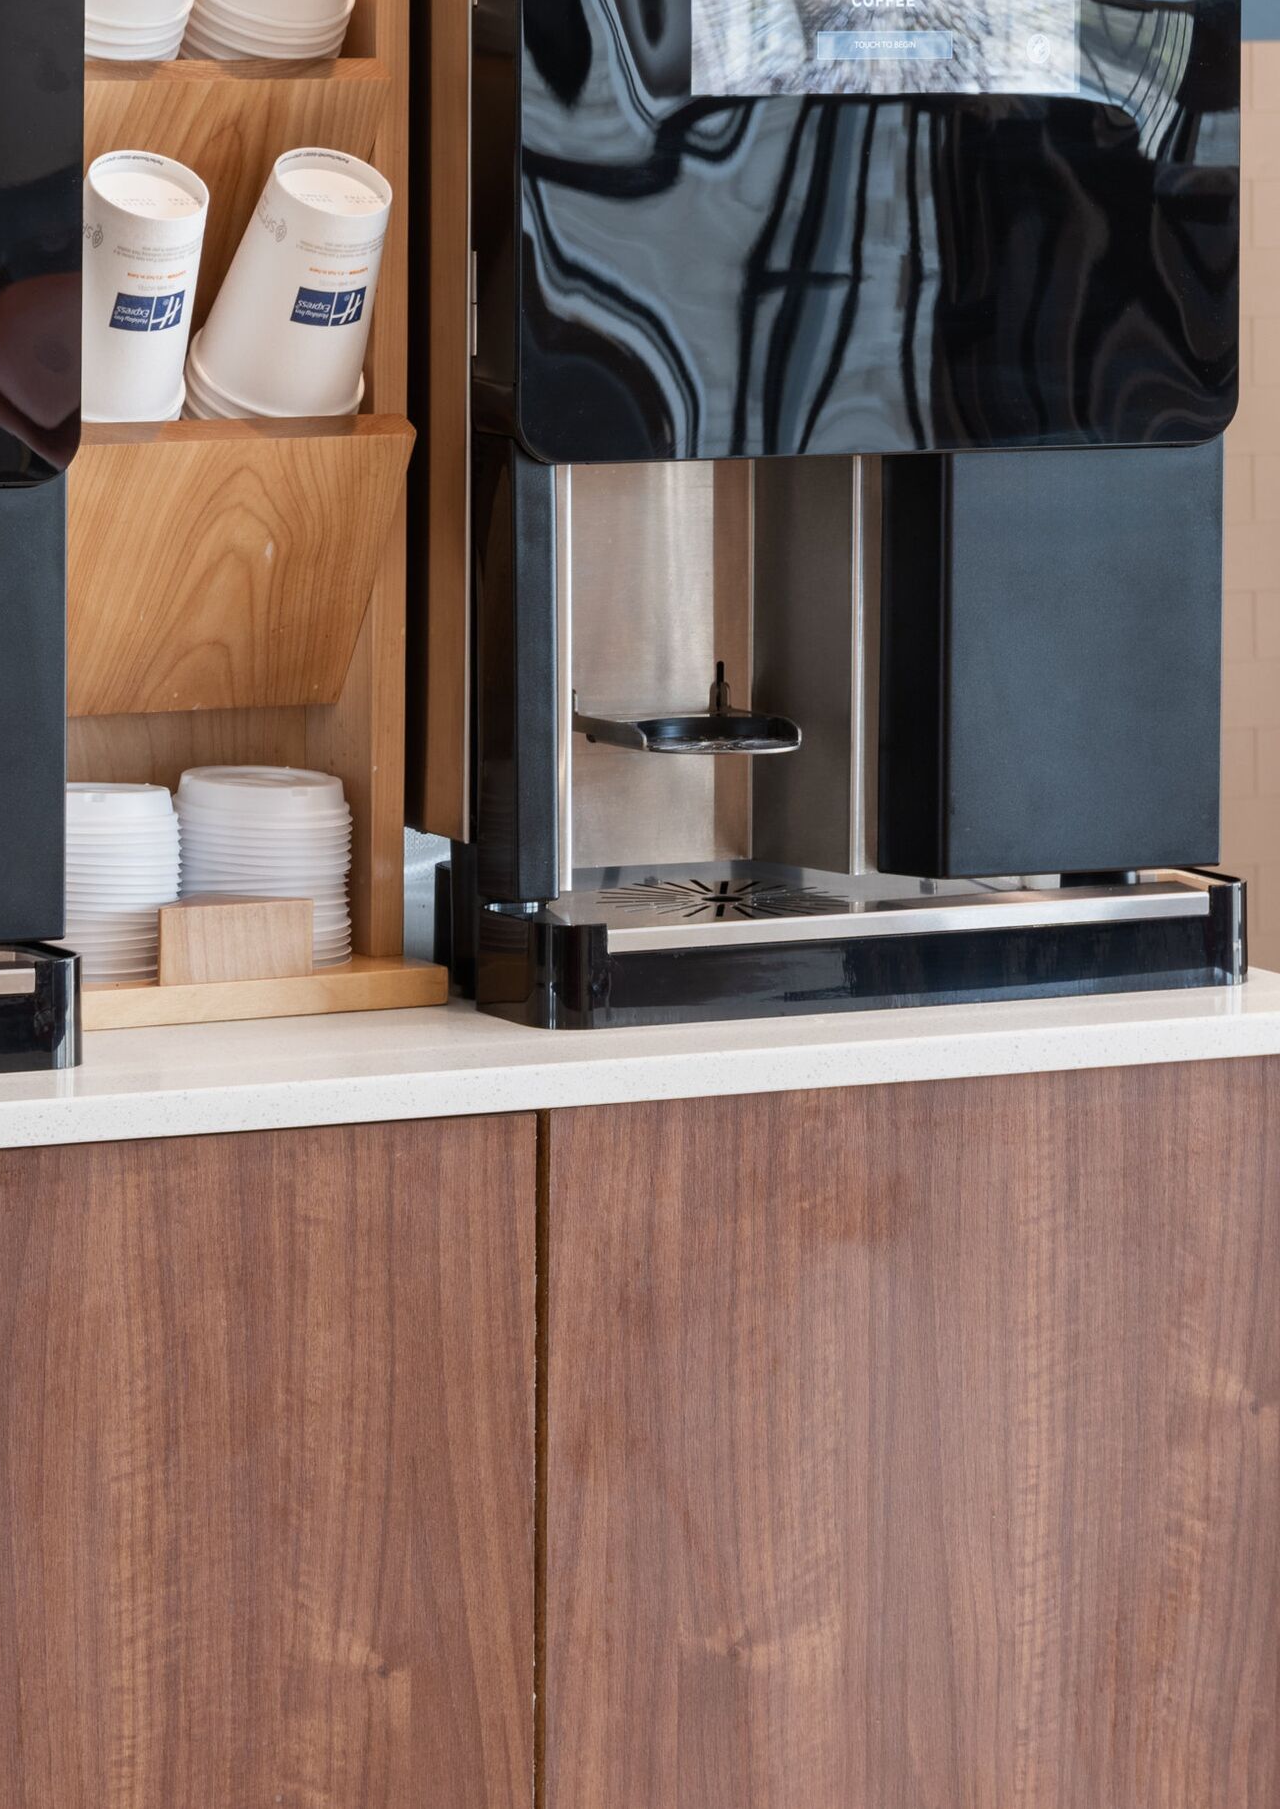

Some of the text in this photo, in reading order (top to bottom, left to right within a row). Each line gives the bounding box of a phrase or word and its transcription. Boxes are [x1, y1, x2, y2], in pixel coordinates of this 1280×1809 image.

[855, 41, 916, 49] TOUCH TO BEGIN
